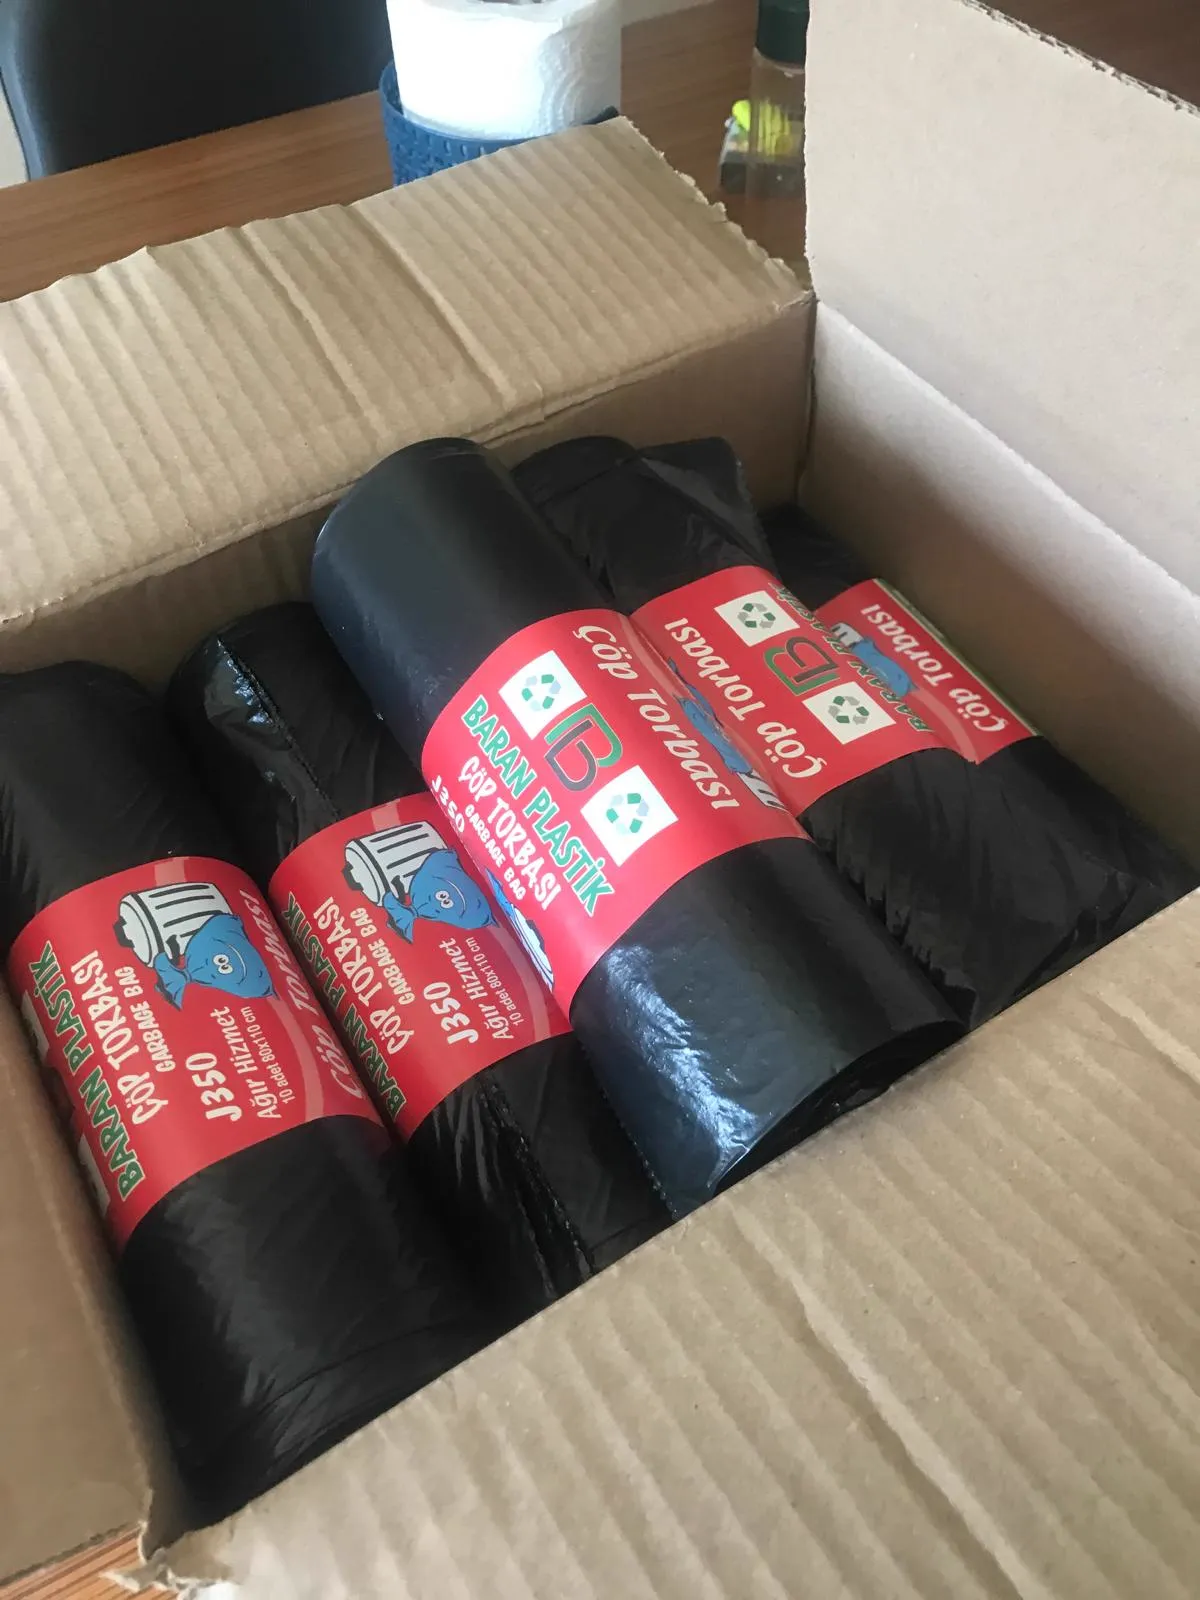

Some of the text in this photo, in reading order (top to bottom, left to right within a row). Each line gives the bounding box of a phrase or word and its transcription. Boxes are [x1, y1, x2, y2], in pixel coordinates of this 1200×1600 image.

[572, 625, 740, 809] Çöp Torbası
[664, 617, 828, 779] Çöp Torbası
[861, 603, 1009, 733] Çöp Torbası
[430, 775, 466, 833] J350
[458, 755, 562, 910] ÇÖP TORBASI
[461, 694, 615, 917] BARAN PLASTİK
[464, 804, 527, 900] GARBAGE BAG
[239, 889, 318, 1017] Torbası
[281, 892, 406, 1121] BARAN PLASTİK
[313, 896, 415, 1055] ÇÖP TORBASI
[350, 907, 415, 1005] GARBAGE BAG
[438, 937, 514, 1040] Ağır Hizmet
[466, 937, 525, 1026] 10 adet 80x110 cm
[29, 940, 145, 1201] BARAN PLASTİK
[71, 951, 168, 1125] ÇÖP TORBASI
[115, 966, 176, 1072] GARBAGE BAG
[210, 1007, 282, 1119] Ağır Hizmet
[241, 1006, 296, 1104] 10 adet 80x110 cm
[423, 982, 479, 1045] J350
[185, 1052, 243, 1122] J350
